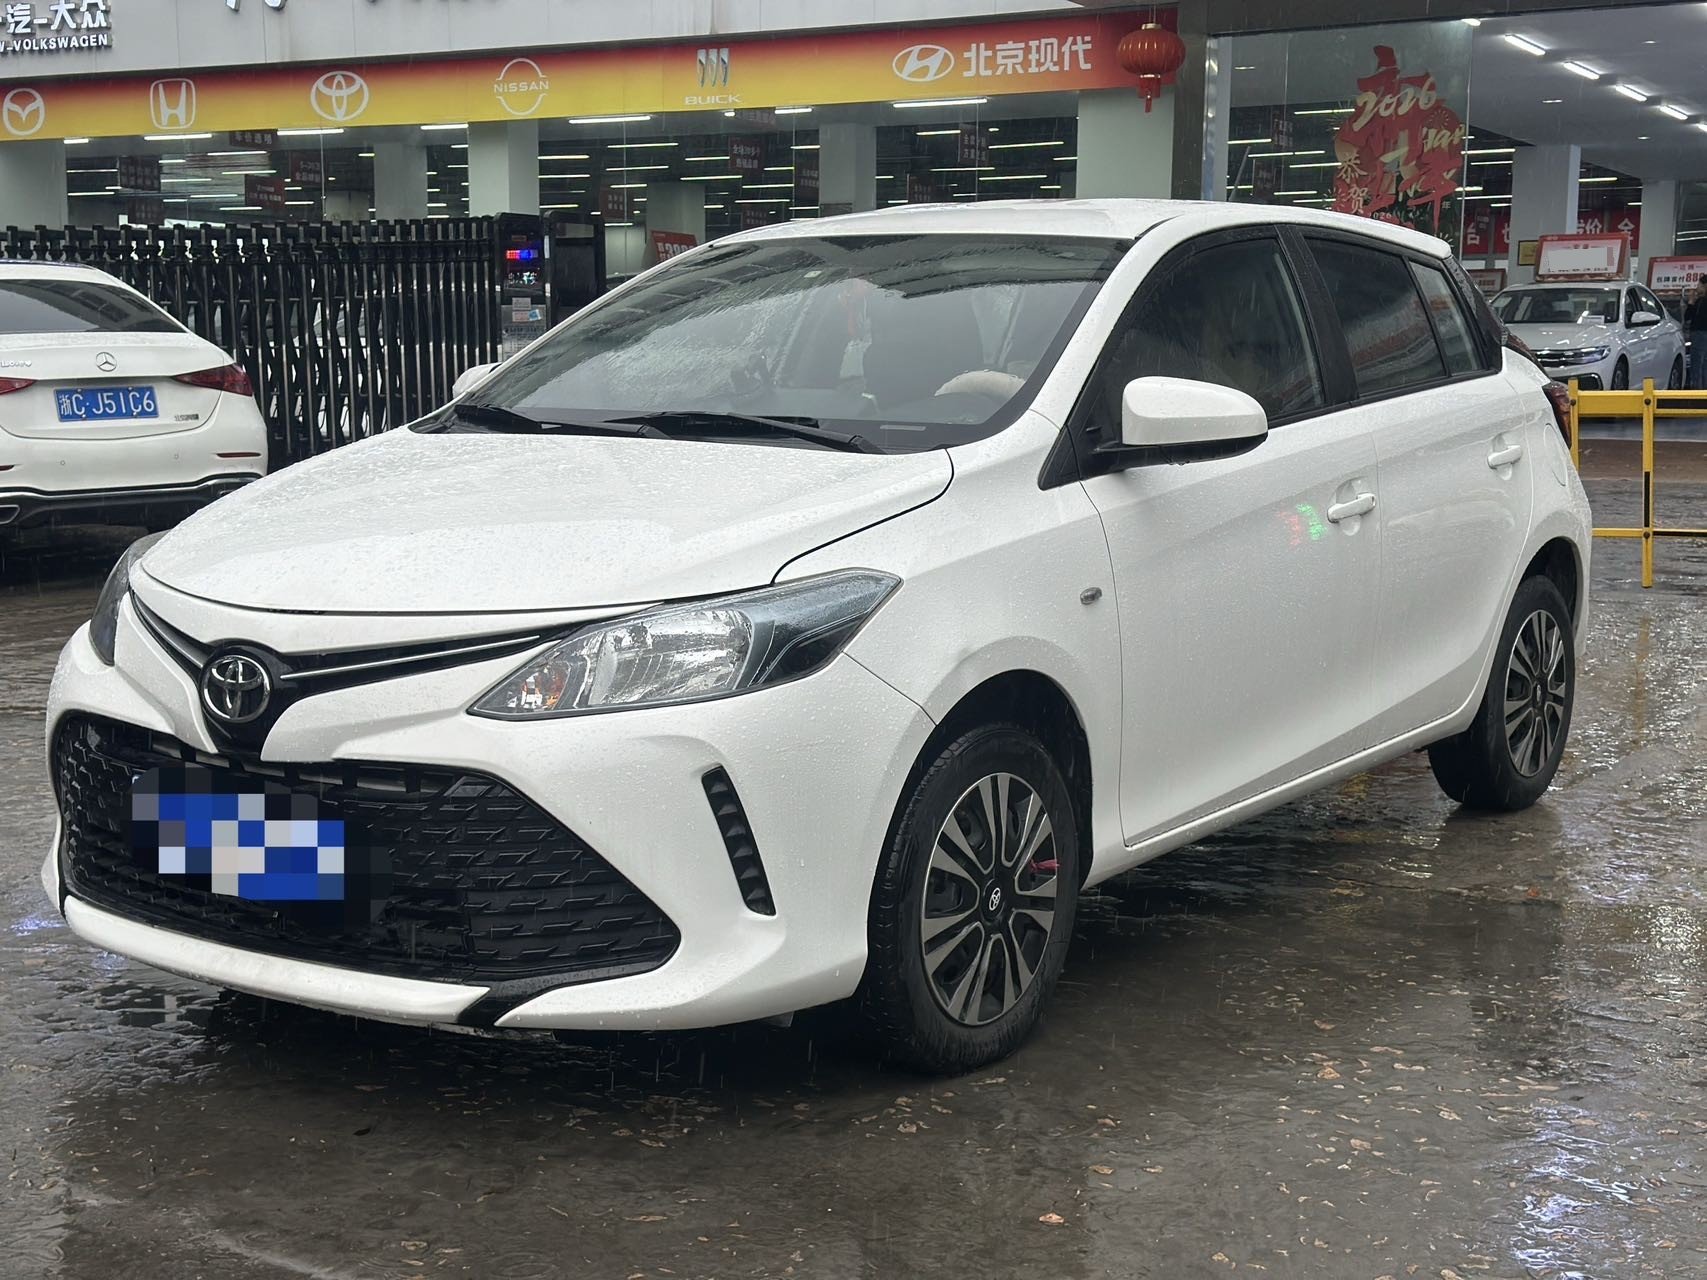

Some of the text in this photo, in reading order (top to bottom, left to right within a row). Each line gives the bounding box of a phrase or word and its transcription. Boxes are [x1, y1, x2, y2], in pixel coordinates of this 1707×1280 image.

[0, 0, 107, 34] 汽-大众
[962, 35, 1092, 78] 北京现代
[493, 80, 550, 93] NISSAN
[684, 93, 742, 106] BUICK
[1352, 76, 1437, 132] 2026
